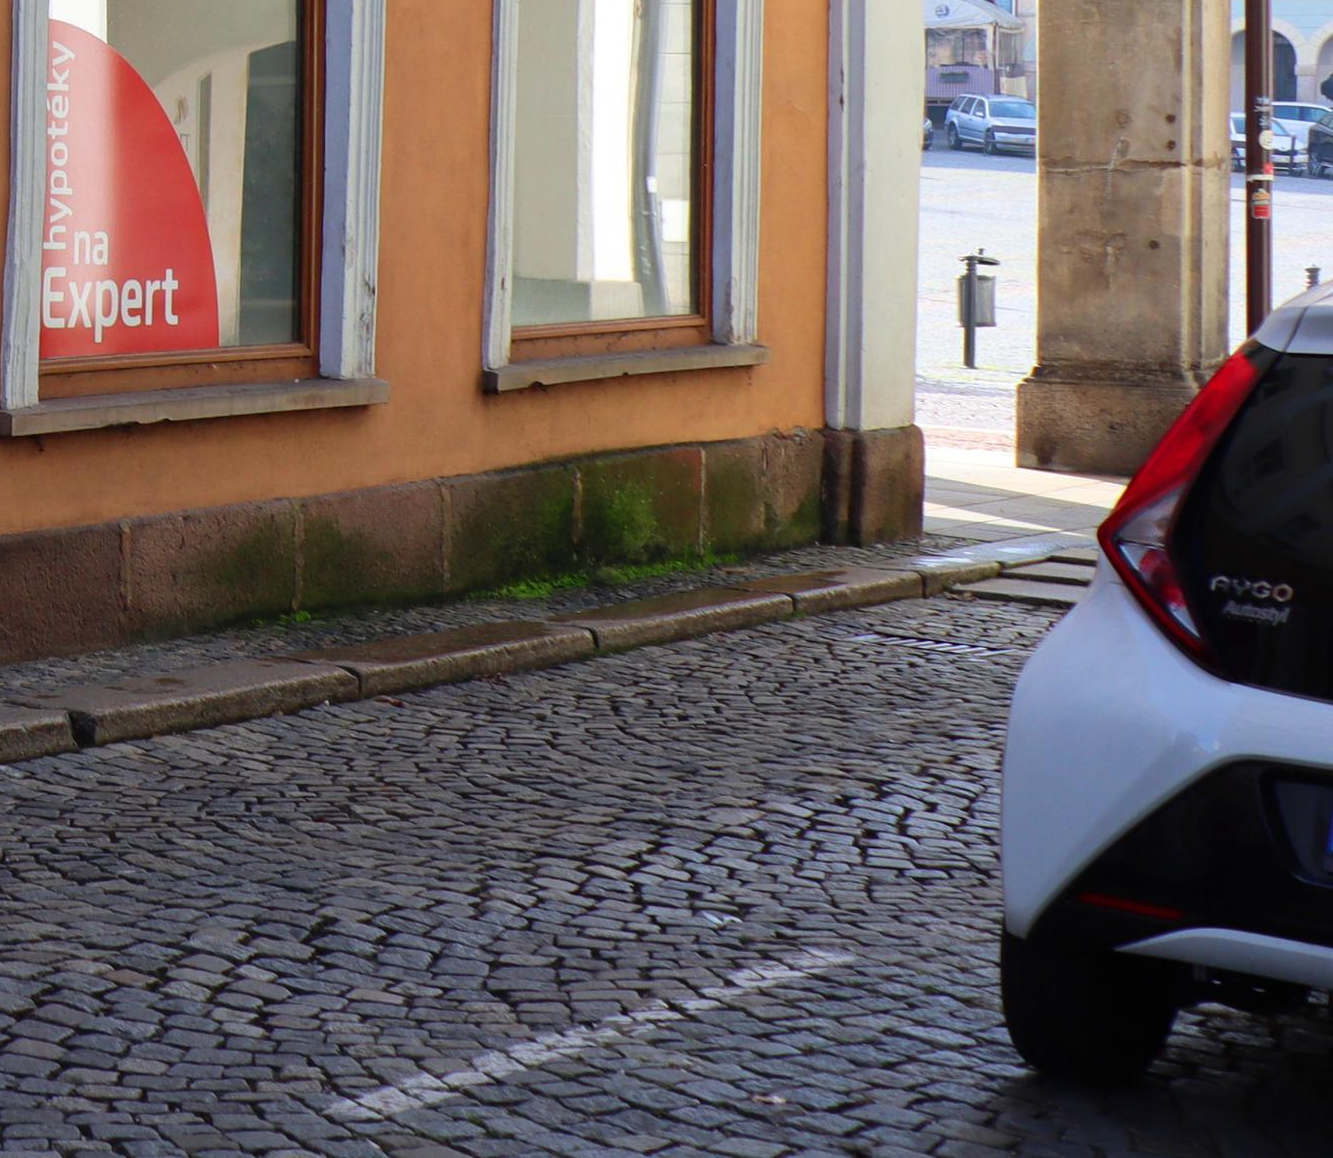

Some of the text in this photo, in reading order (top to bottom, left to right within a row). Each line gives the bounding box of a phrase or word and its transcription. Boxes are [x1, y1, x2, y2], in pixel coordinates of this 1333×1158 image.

[42, 40, 77, 251] hypotéky
[72, 229, 110, 267] na
[42, 267, 180, 344] Expert
